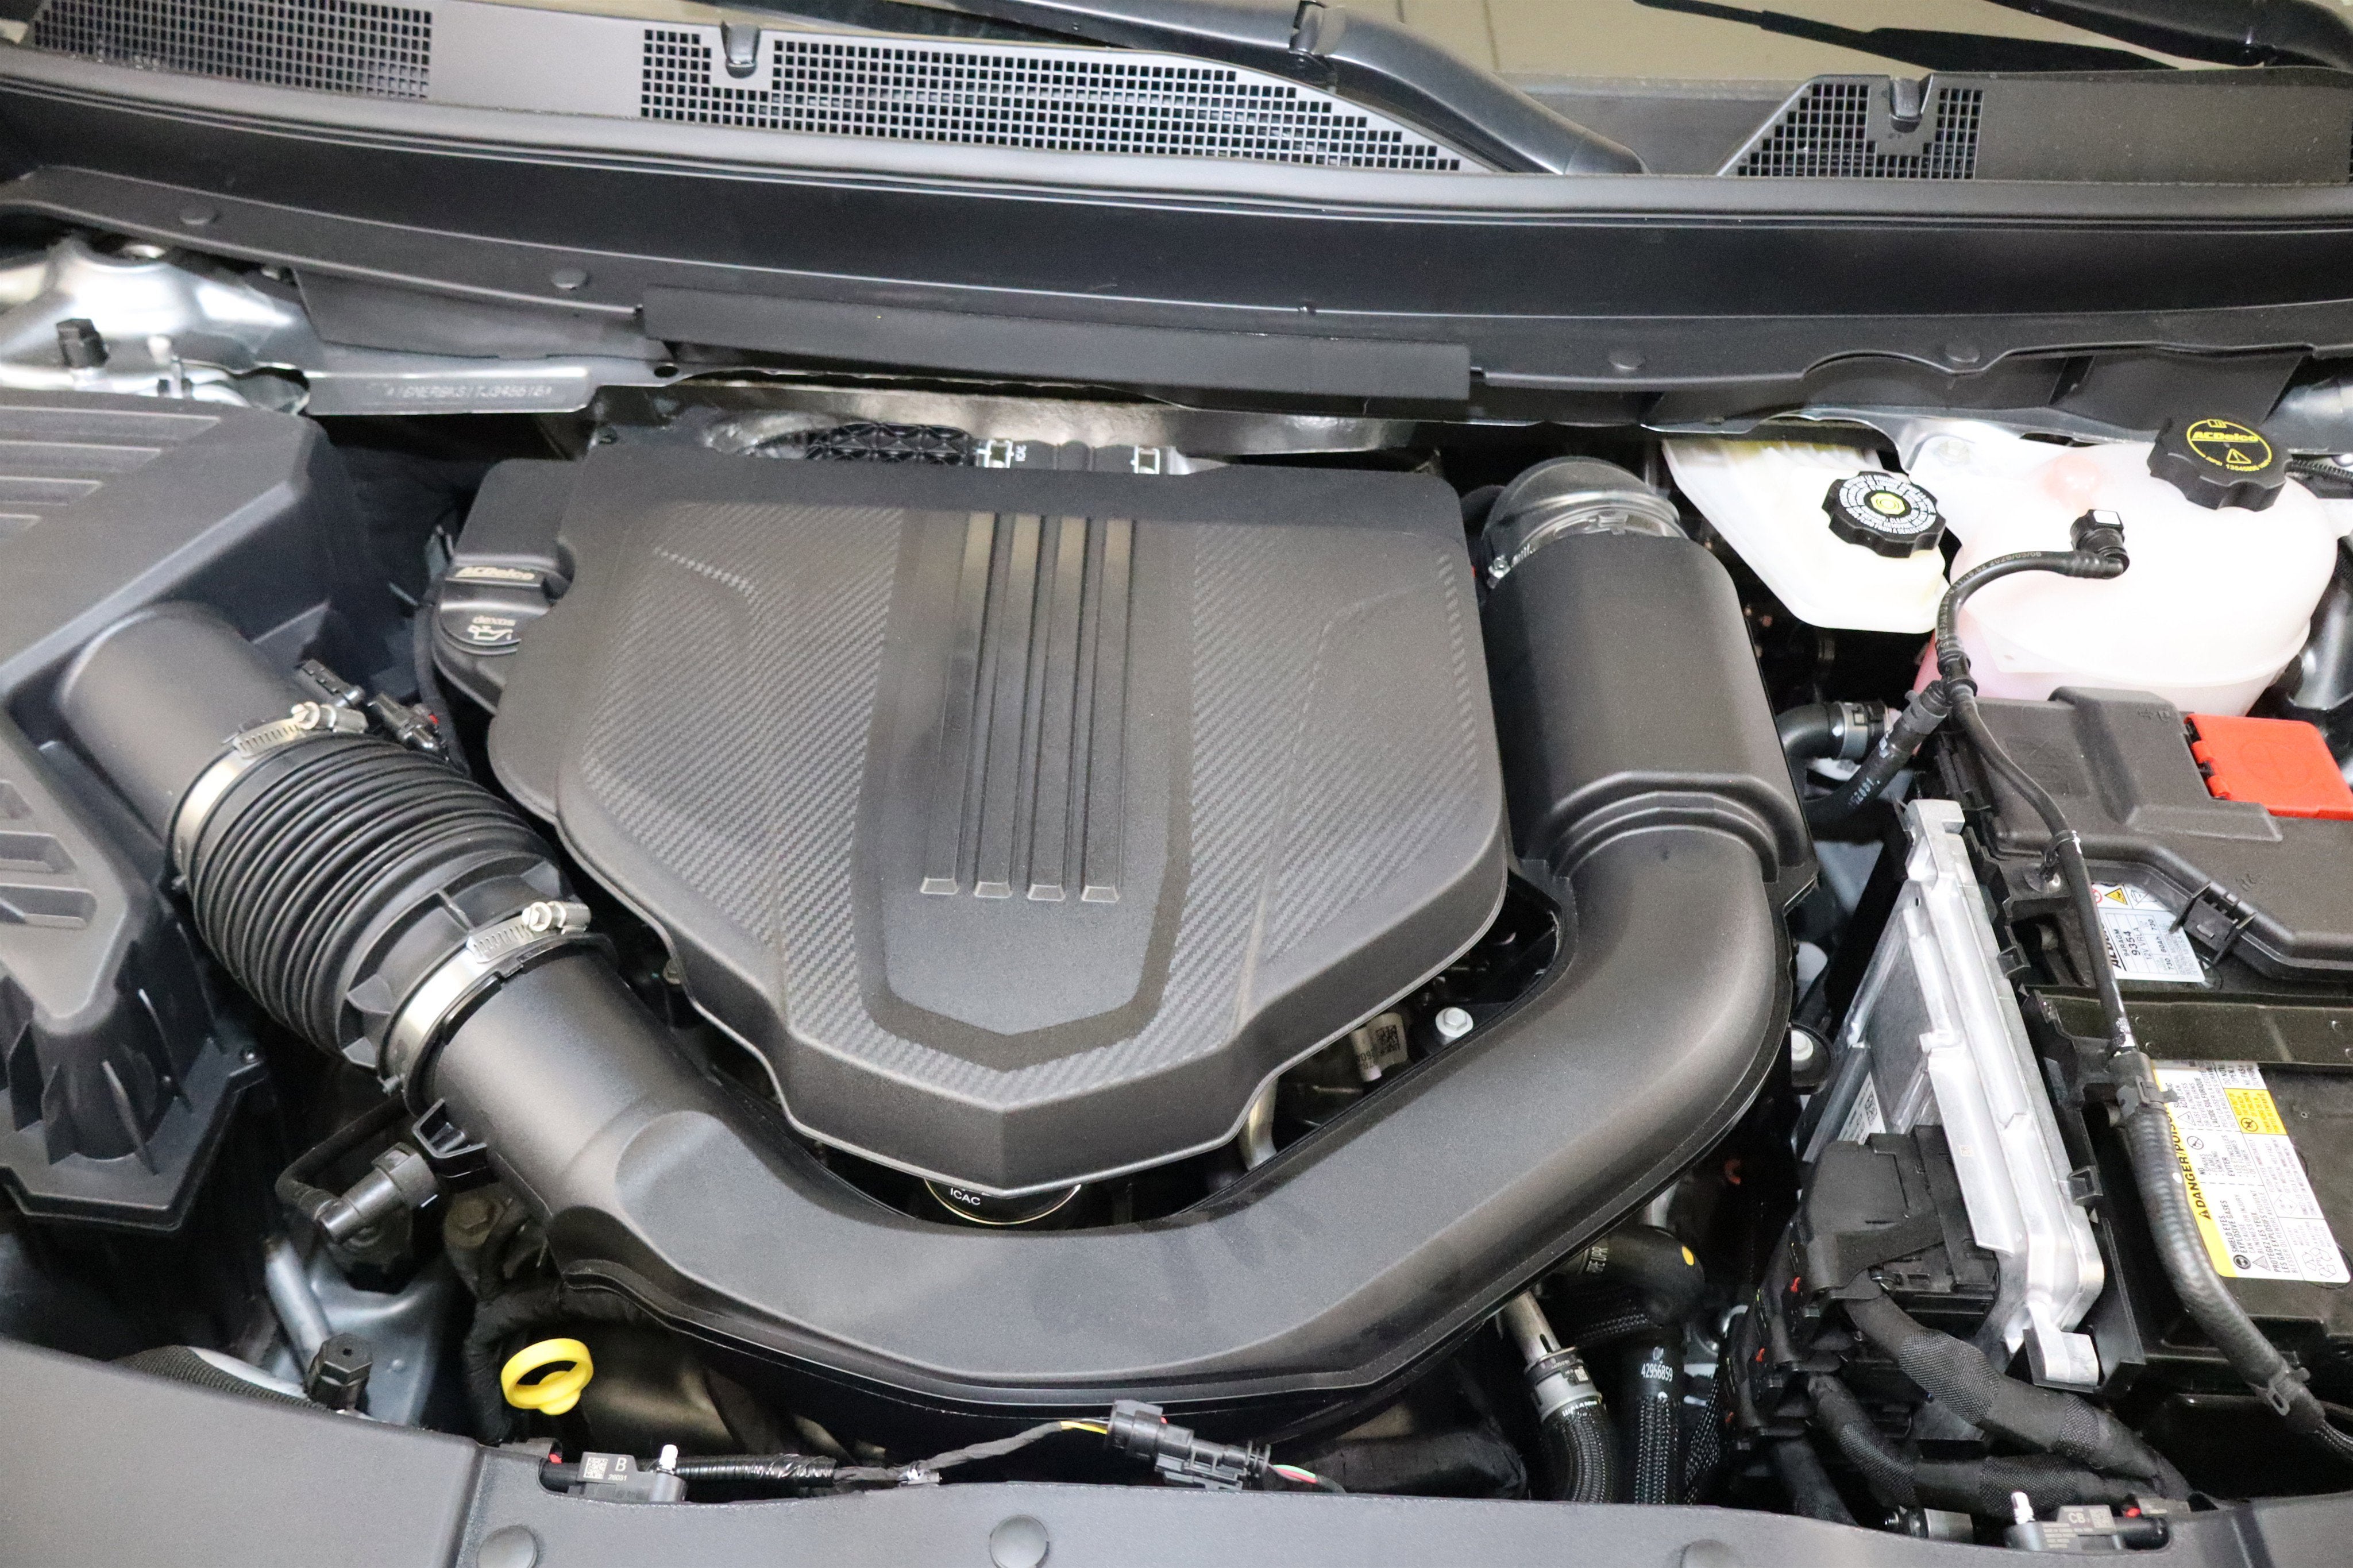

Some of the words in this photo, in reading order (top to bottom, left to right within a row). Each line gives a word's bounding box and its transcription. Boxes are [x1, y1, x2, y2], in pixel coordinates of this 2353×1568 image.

[2192, 431, 2259, 442] ACDelco
[454, 566, 536, 581] ACDelco
[472, 615, 516, 627] dexos
[2147, 918, 2158, 930] 730
[2113, 929, 2130, 956] 94RAGM
[2123, 930, 2141, 955] 9354
[2133, 927, 2146, 946] VRLA
[2155, 936, 2167, 952] 80Ah
[2141, 947, 2153, 959] 12V
[2163, 957, 2174, 970] 730
[2165, 1082, 2181, 1108] SURIC
[2173, 1084, 2182, 1094] CAN
[2181, 1082, 2197, 1109] BLINDNESS
[2188, 1082, 2200, 1099] BURNS
[2193, 1077, 2212, 1107] SULFURIQUE
[2178, 1096, 2189, 1108] ACID
[2196, 1100, 2208, 1118] SEVERE
[2209, 1095, 2223, 1114] CAUSER
[2192, 1111, 2204, 1126] CAUSE
[2217, 1115, 2229, 1127] PEUT
[2223, 1110, 2233, 1120] DES
[2229, 1140, 2244, 1163] FLAMMES
[2239, 1149, 2252, 1167] FUMER
[2199, 1153, 2212, 1172] SPARKS
[2205, 1153, 2218, 1172] FLAMES
[2210, 1150, 2224, 1172] SMOKING
[2233, 1164, 2242, 1173] LES
[2240, 1164, 2249, 1173] LES
[951, 1187, 981, 1206] ICAC
[2249, 1189, 2265, 1214] PEUVENT
[2258, 1191, 2274, 1215] AVEUGLE
[2219, 1200, 2234, 1219] GASES
[2238, 1223, 2251, 1241] CAUSE
[2257, 1230, 2268, 1239] LES
[2259, 1215, 2279, 1246] EXPLOSIFS
[2268, 1216, 2283, 1238] RENDRE
[2224, 1232, 2239, 1252] SHIELD
[2227, 1221, 2248, 1253] EXPLOSIVE
[2246, 1223, 2265, 1254] BLINDNESS
[2245, 1242, 2256, 1253] CAN
[2273, 1248, 2285, 1260] GAZ
[2279, 1262, 2290, 1273] LES
[2281, 1249, 2298, 1273] BLESSER
[1641, 1363, 1673, 1382] 42956859
[615, 1457, 627, 1472] B
[608, 1473, 628, 1482] 26031
[2067, 1512, 2086, 1524] CB
